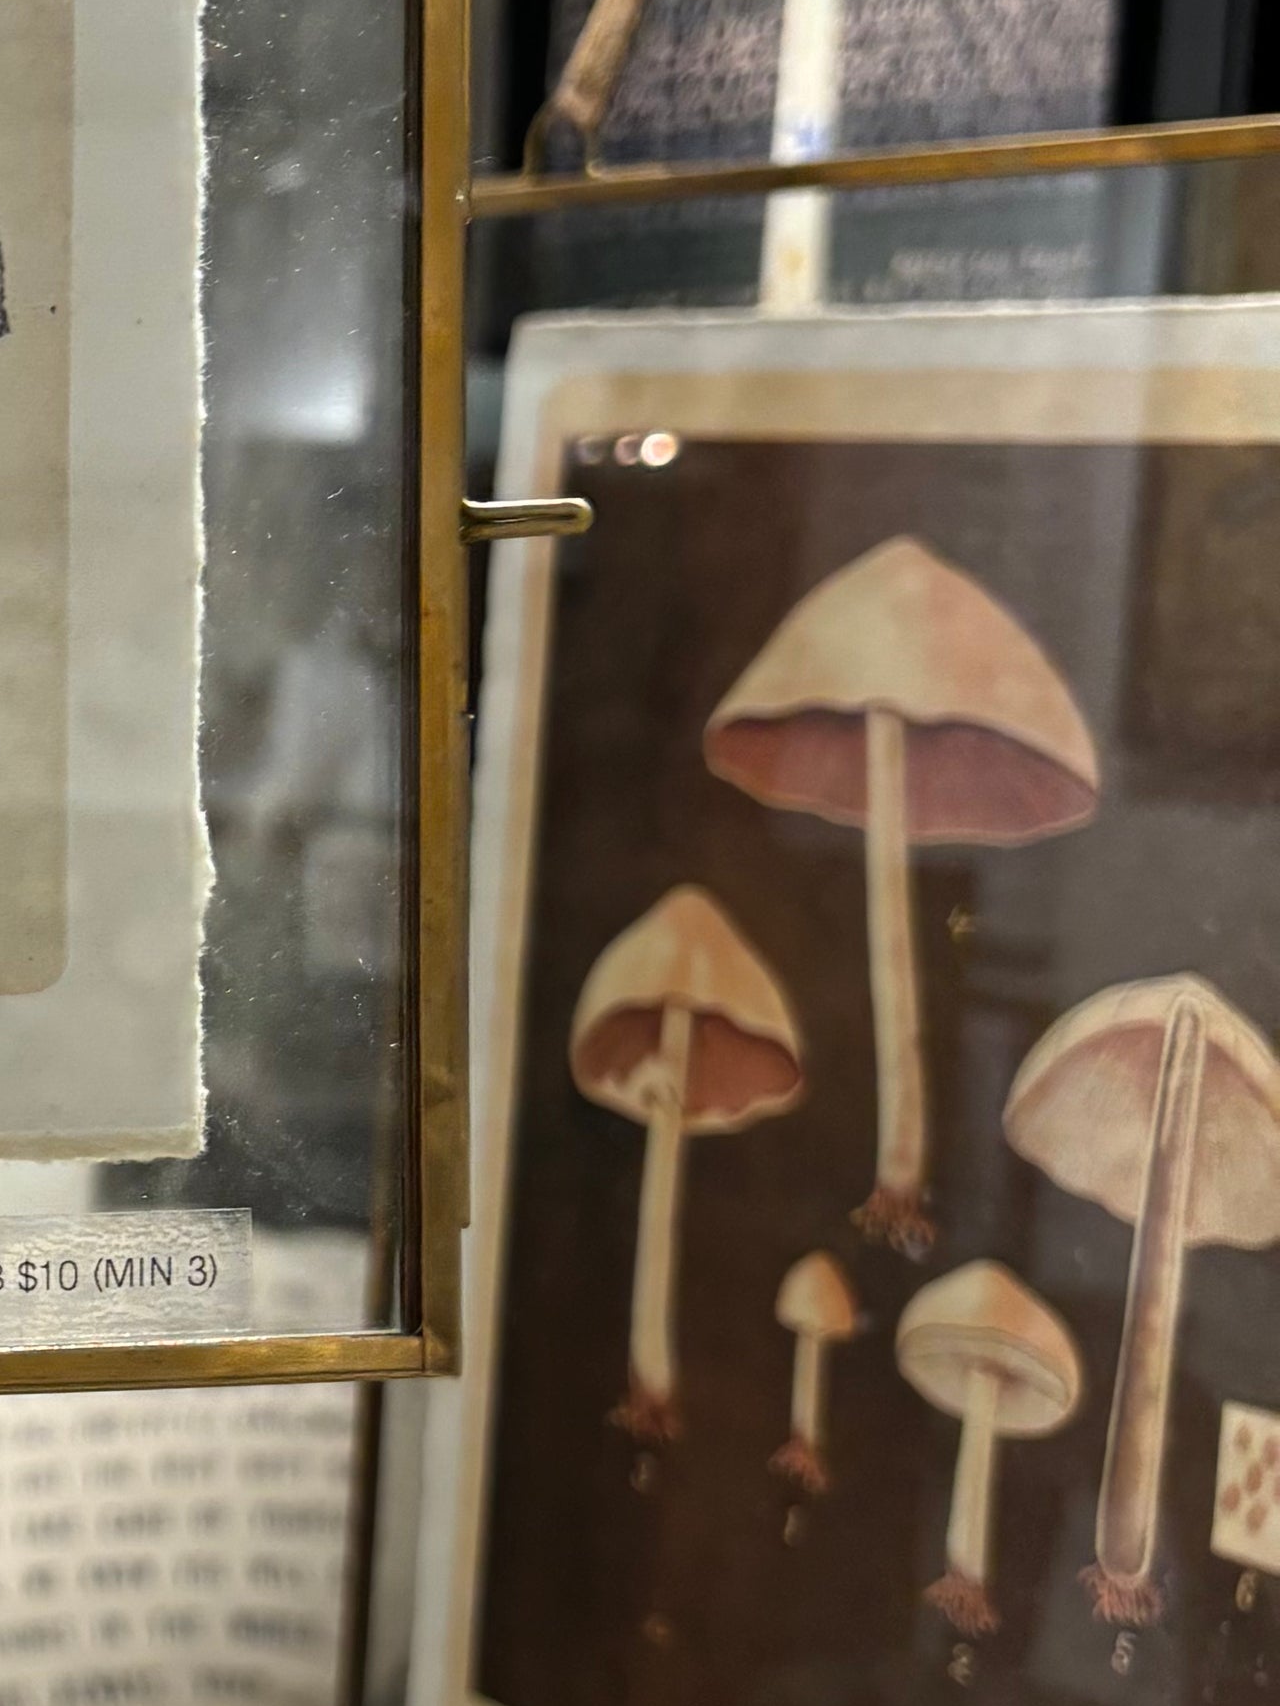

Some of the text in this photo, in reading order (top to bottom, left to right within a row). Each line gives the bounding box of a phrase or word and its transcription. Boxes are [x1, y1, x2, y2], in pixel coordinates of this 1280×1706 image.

[17, 1259, 80, 1293] $10
[93, 1254, 173, 1292] (MIN
[187, 1253, 218, 1290] 3)
